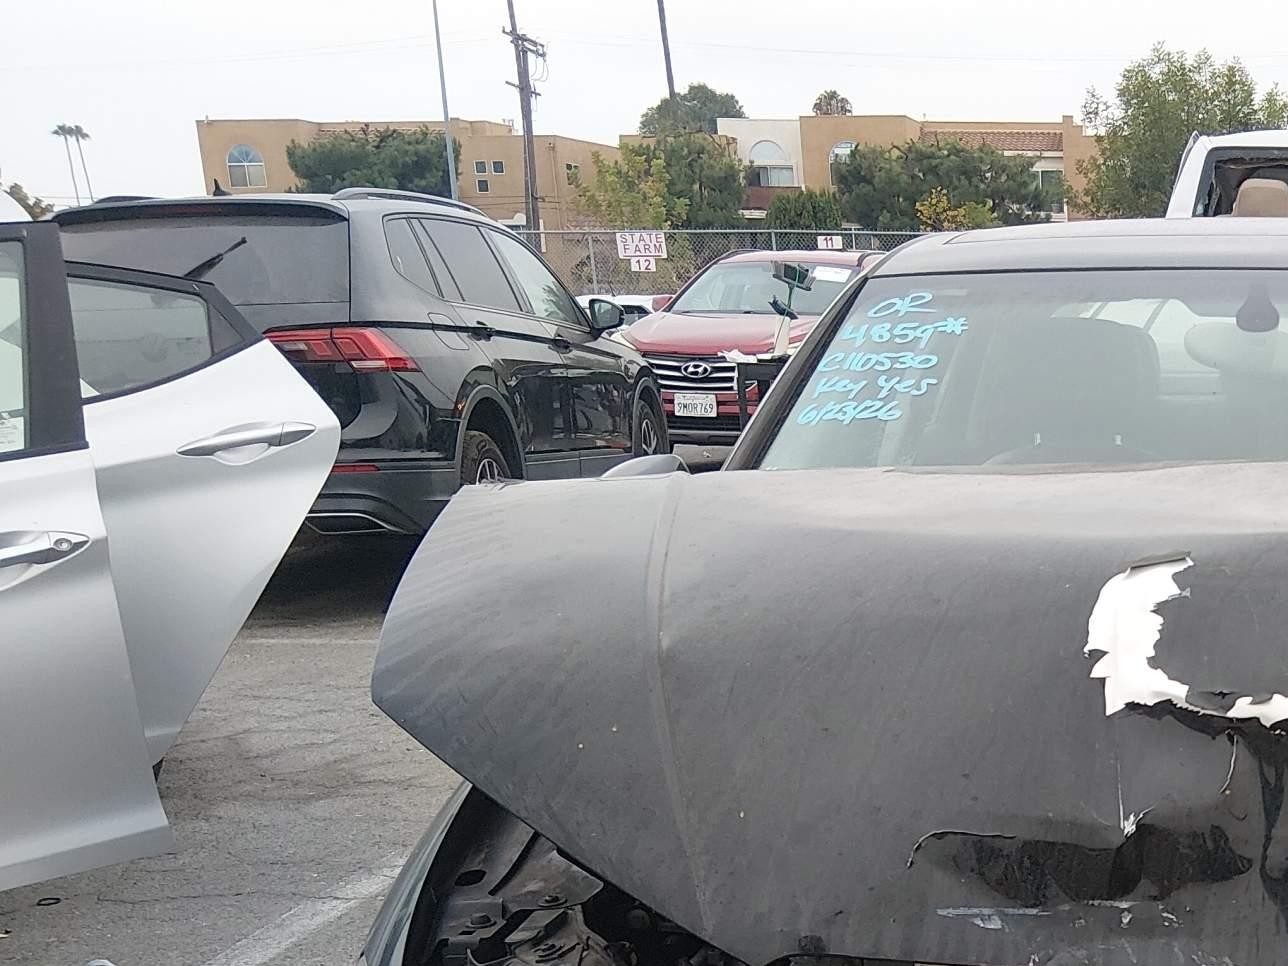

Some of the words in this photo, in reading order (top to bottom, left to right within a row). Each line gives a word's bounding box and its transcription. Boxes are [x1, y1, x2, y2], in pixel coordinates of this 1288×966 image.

[620, 233, 663, 243] STATE
[823, 236, 833, 248] 11
[623, 243, 663, 254] FARM
[635, 259, 651, 270] 12
